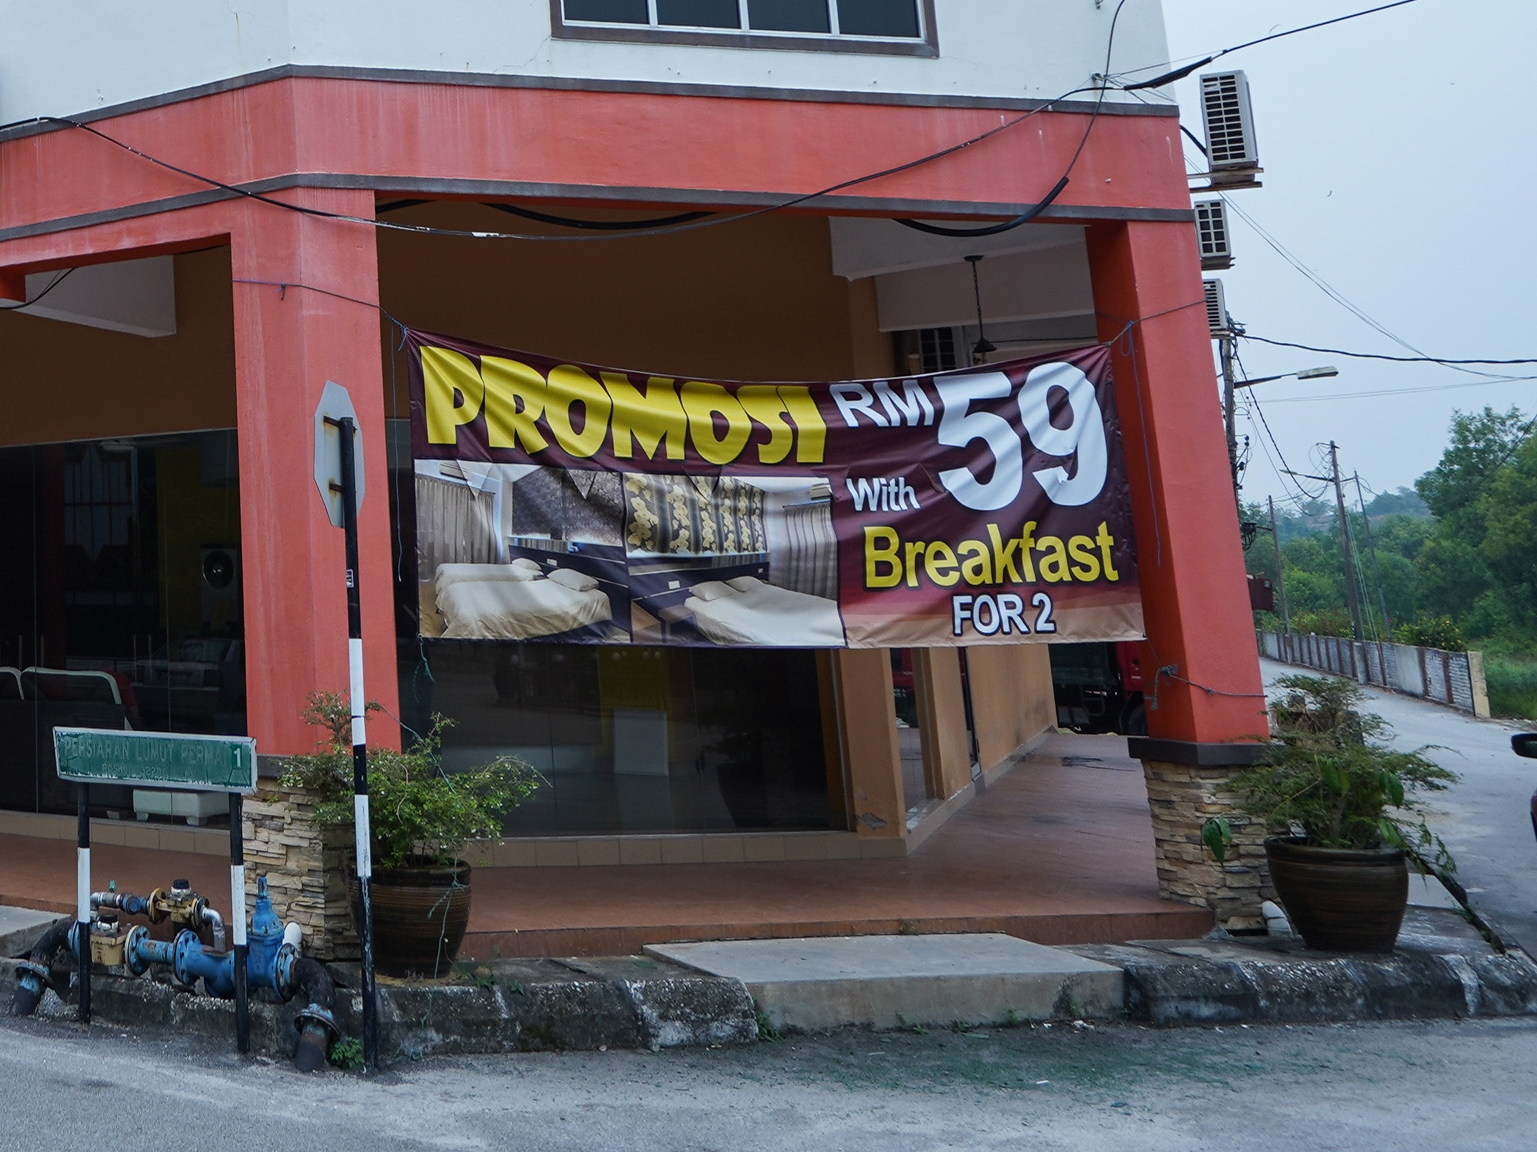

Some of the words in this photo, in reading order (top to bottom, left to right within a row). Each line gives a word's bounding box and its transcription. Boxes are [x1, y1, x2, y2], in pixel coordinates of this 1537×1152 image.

[419, 345, 827, 465] PROMOSI
[846, 477, 920, 512] With
[863, 521, 1119, 588] Breakfast
[952, 594, 1030, 635] FOR
[1032, 592, 1057, 633] 2
[64, 738, 130, 760] PERSIARAN
[135, 742, 174, 762] LUMUT
[233, 747, 242, 768] 1
